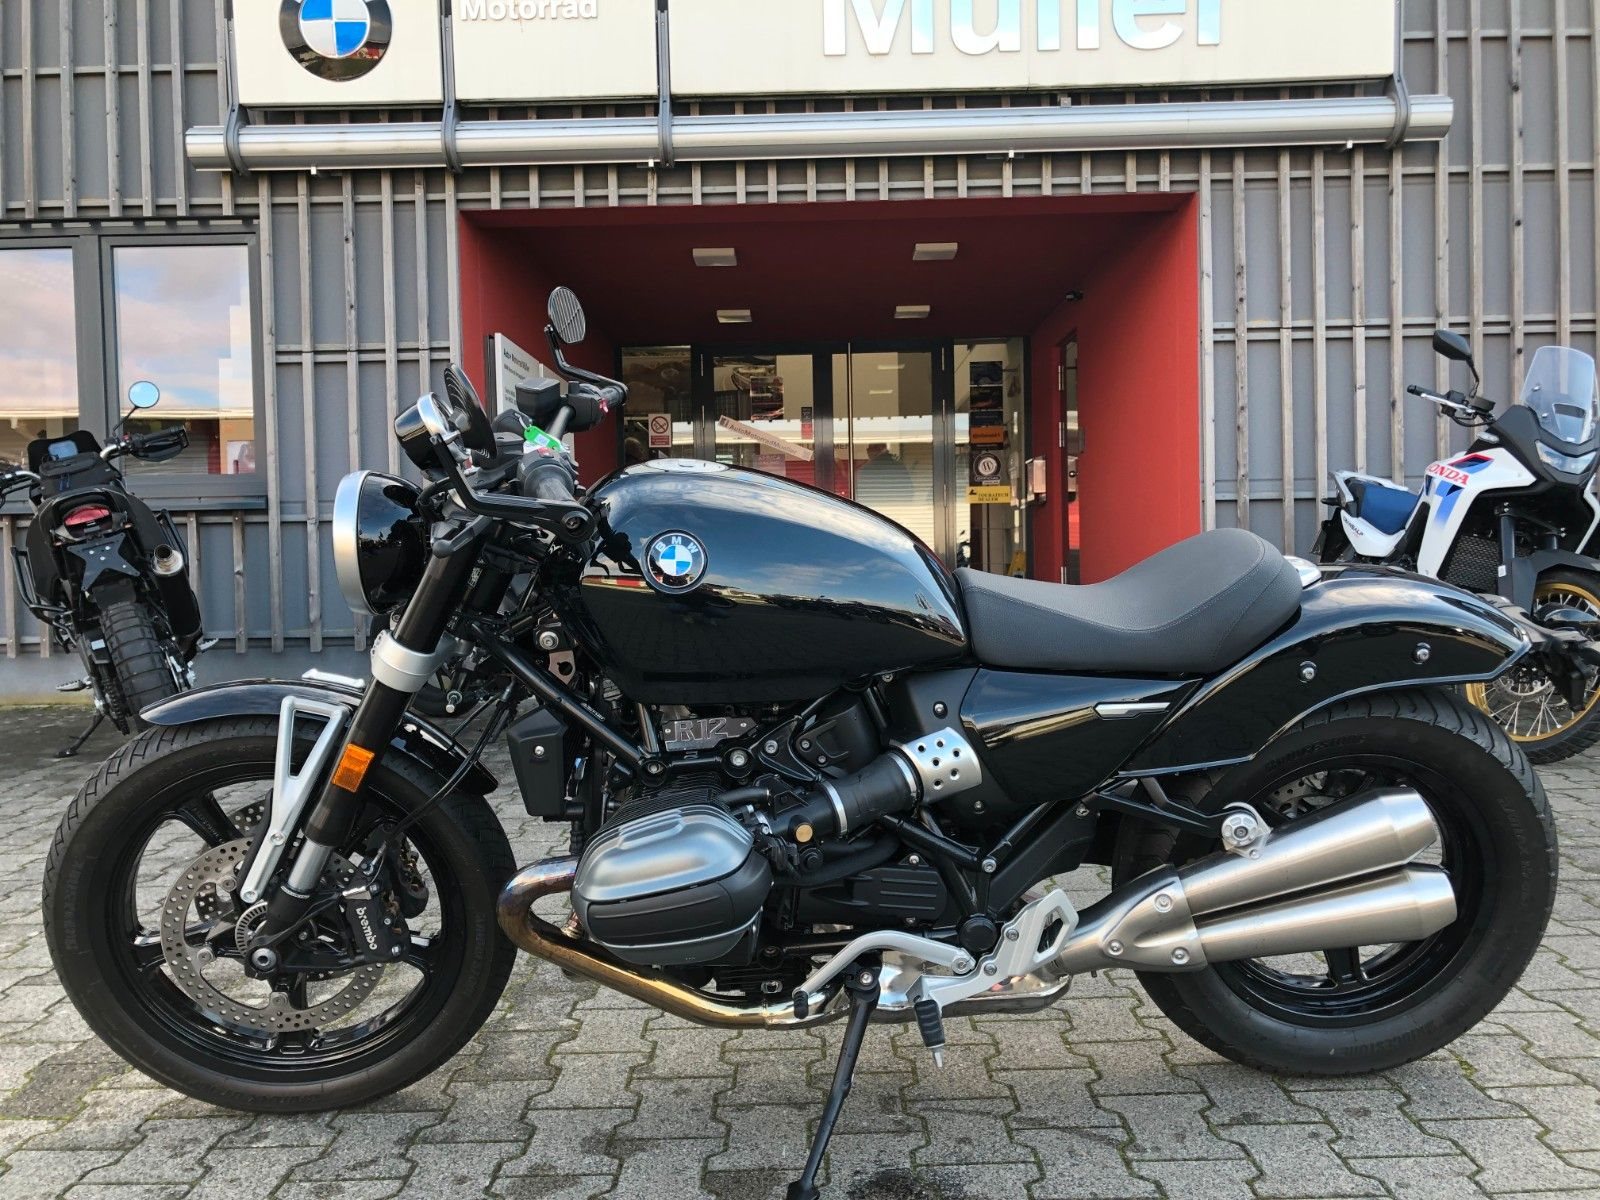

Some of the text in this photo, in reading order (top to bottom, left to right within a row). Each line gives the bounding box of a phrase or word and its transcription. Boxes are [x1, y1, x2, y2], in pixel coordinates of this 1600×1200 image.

[460, 0, 598, 20] Motorrad
[1426, 463, 1470, 485] ONDA
[655, 536, 699, 554] BMW
[356, 906, 378, 951] brembo
